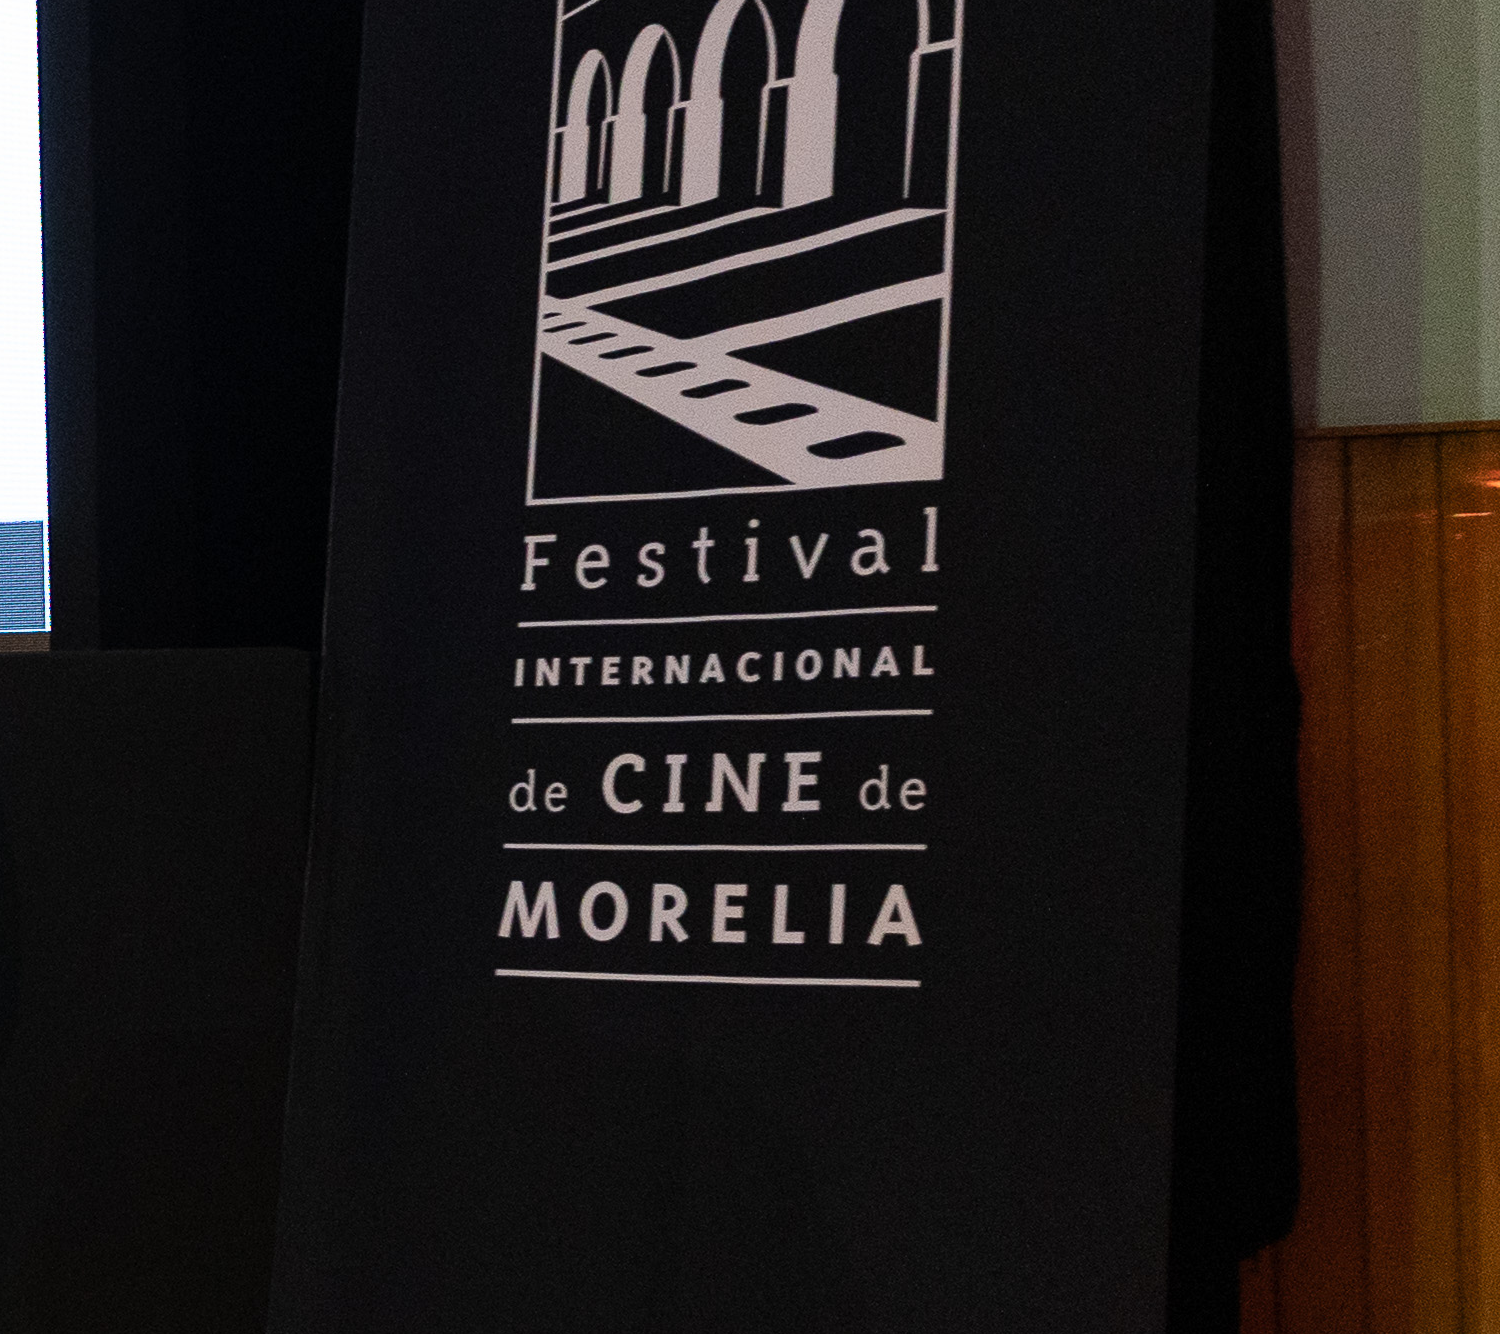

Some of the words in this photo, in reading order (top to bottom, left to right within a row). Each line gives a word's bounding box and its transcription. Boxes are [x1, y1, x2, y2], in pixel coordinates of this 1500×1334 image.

[521, 506, 938, 590] Festival
[515, 645, 933, 686] INTERNACIONAL
[509, 769, 567, 812] de
[603, 752, 821, 813] CINE
[860, 765, 926, 810] de
[499, 881, 922, 946] MORELIA
